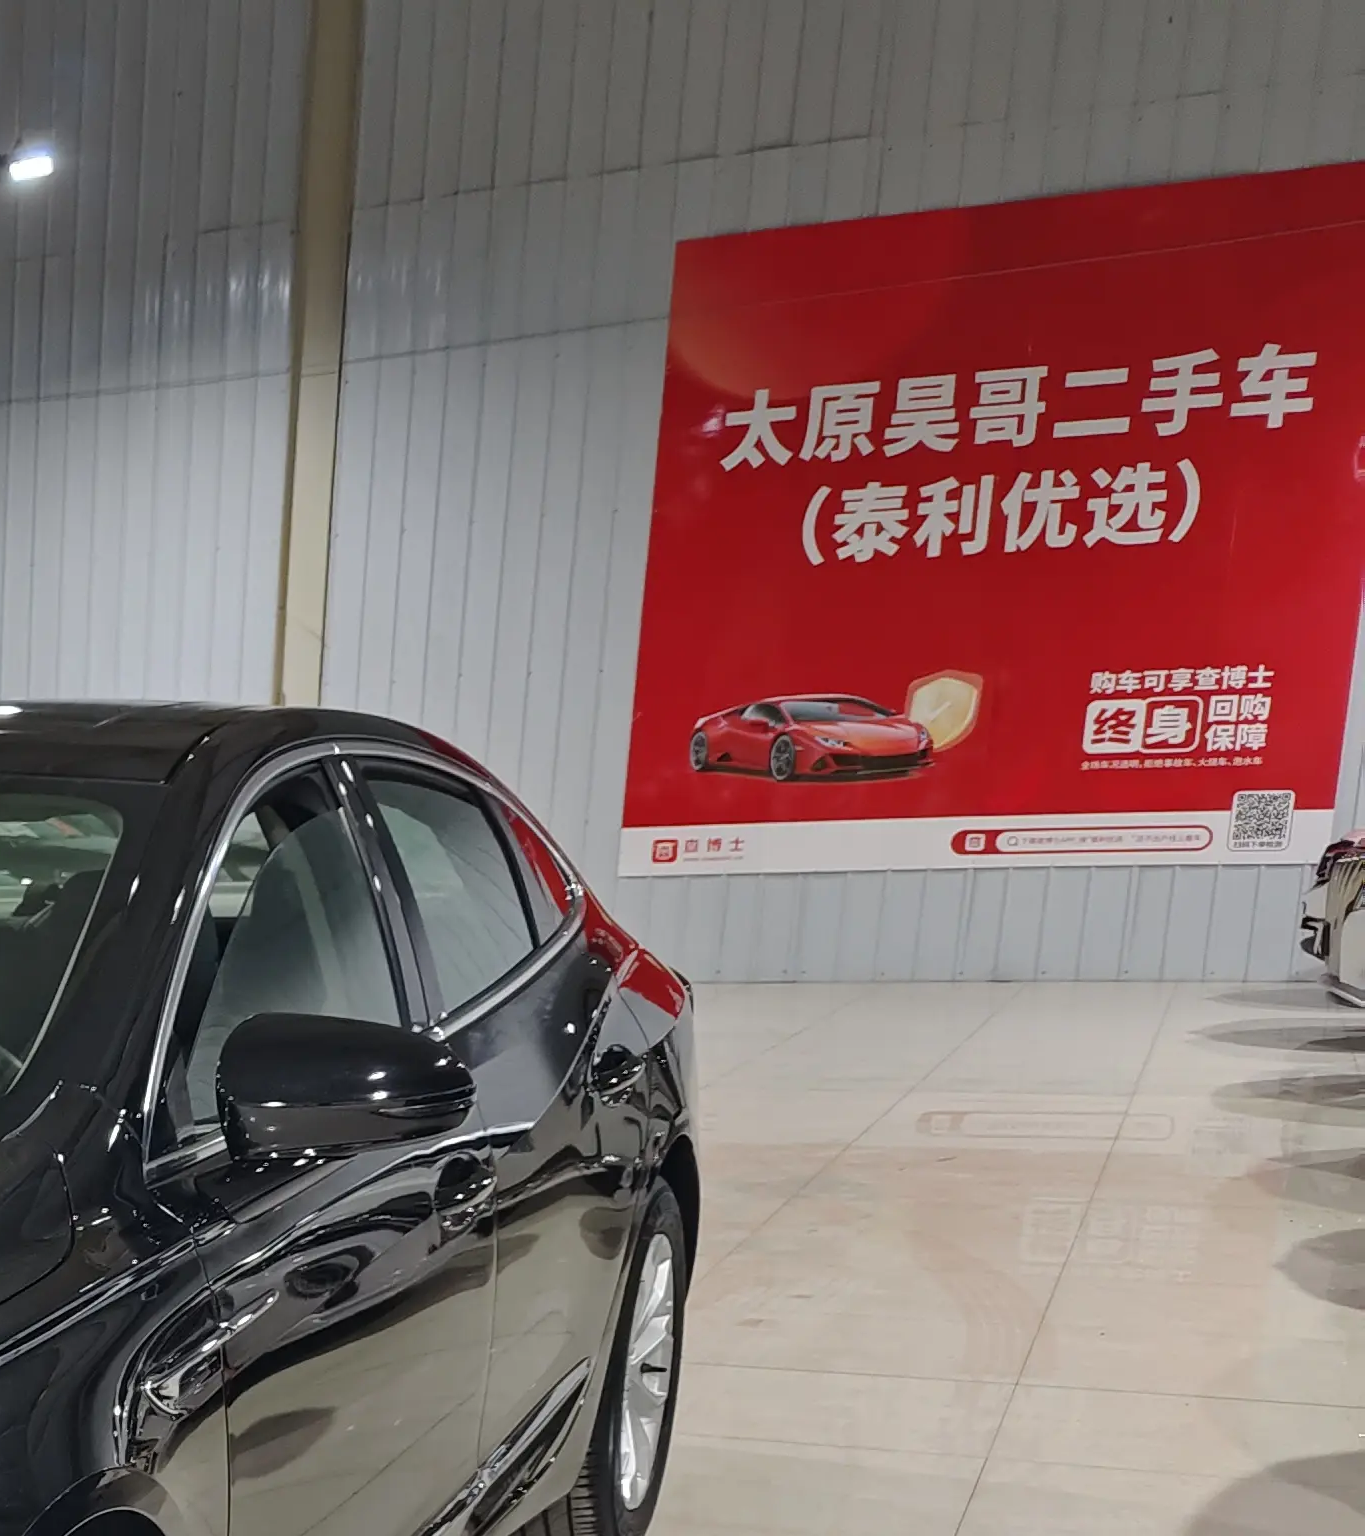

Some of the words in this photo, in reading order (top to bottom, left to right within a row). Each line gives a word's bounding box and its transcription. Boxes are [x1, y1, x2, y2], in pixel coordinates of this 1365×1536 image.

[719, 342, 1318, 472] 太原昊哥二手车
[1089, 664, 1275, 694] 购车可享查博士
[1207, 694, 1272, 722] 回购
[1088, 703, 1195, 746] 终身
[1204, 723, 1268, 752] 保障
